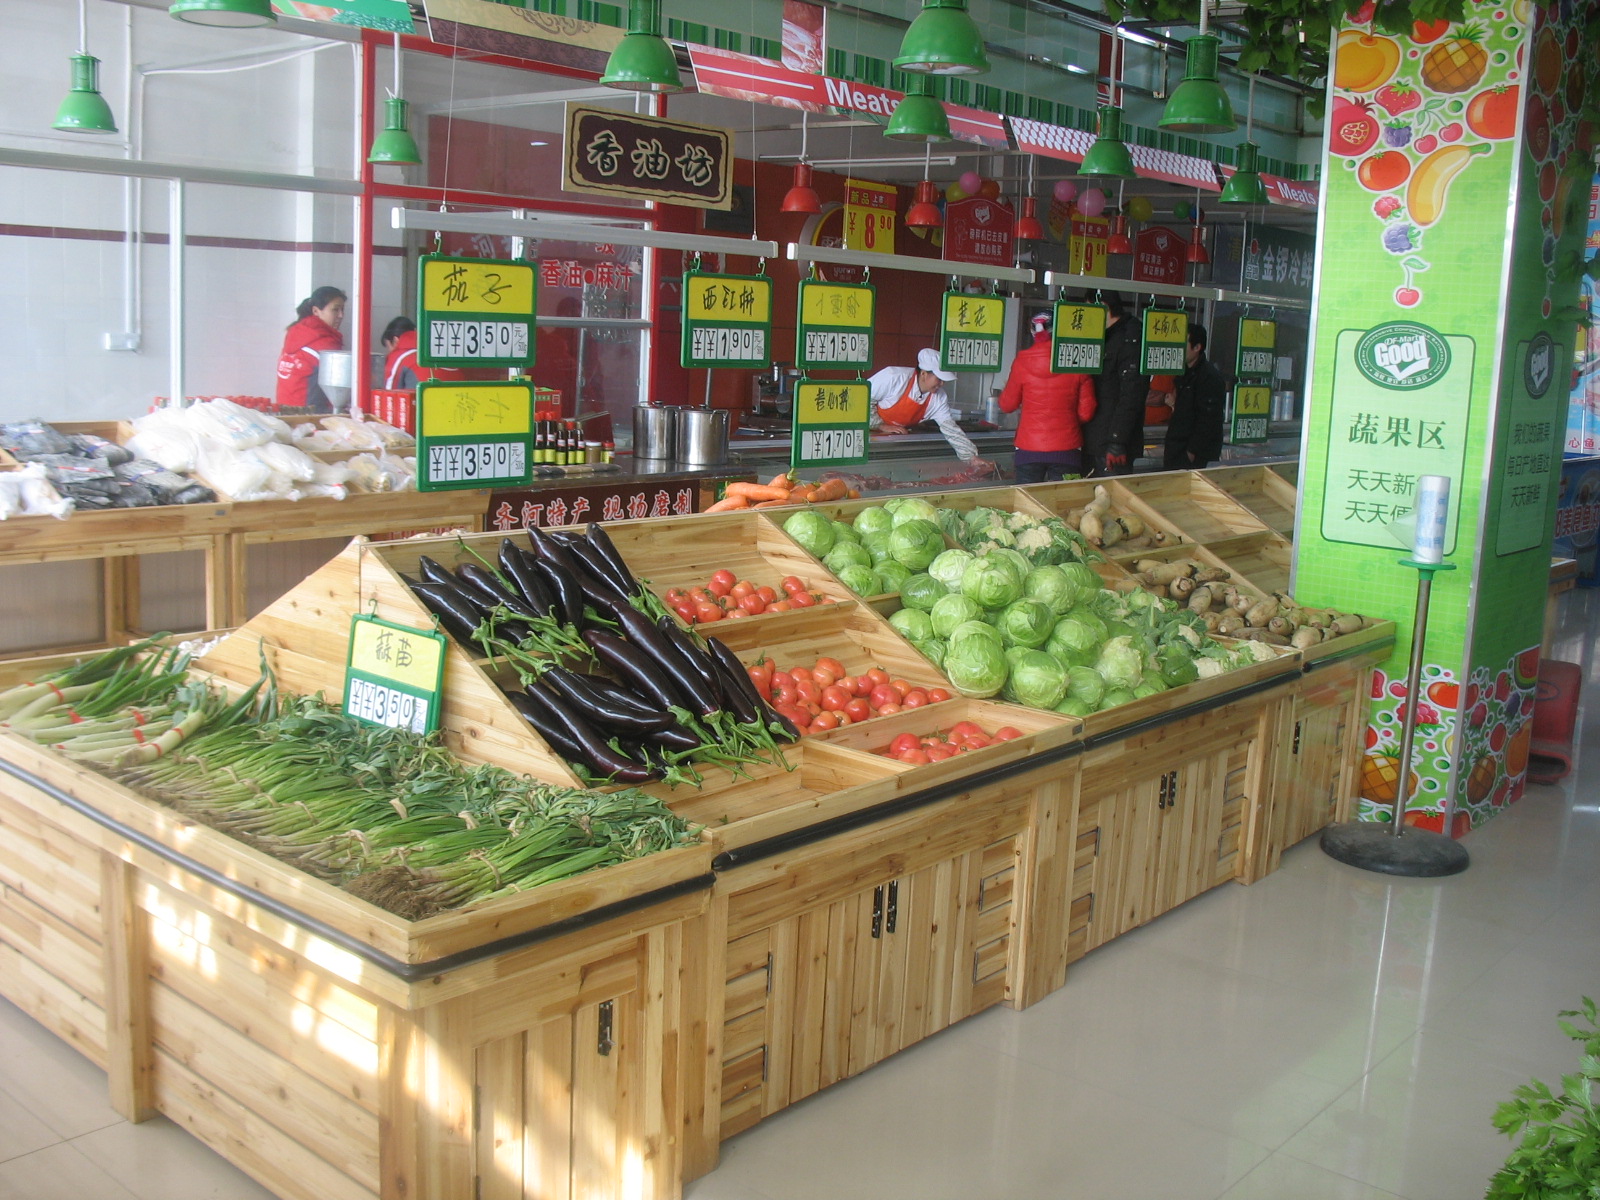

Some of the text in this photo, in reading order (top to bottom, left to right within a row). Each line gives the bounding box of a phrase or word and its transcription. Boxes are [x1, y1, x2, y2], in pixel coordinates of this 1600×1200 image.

[824, 77, 901, 116] Meats
[586, 130, 714, 185] 香油坊
[1276, 181, 1317, 205] Meats
[442, 264, 513, 307] 茄子
[1374, 335, 1429, 368] Good
[1348, 413, 1447, 450] 蔬果区
[1347, 468, 1420, 496] 天天新
[493, 487, 693, 531] 齐河特产 现场磨制
